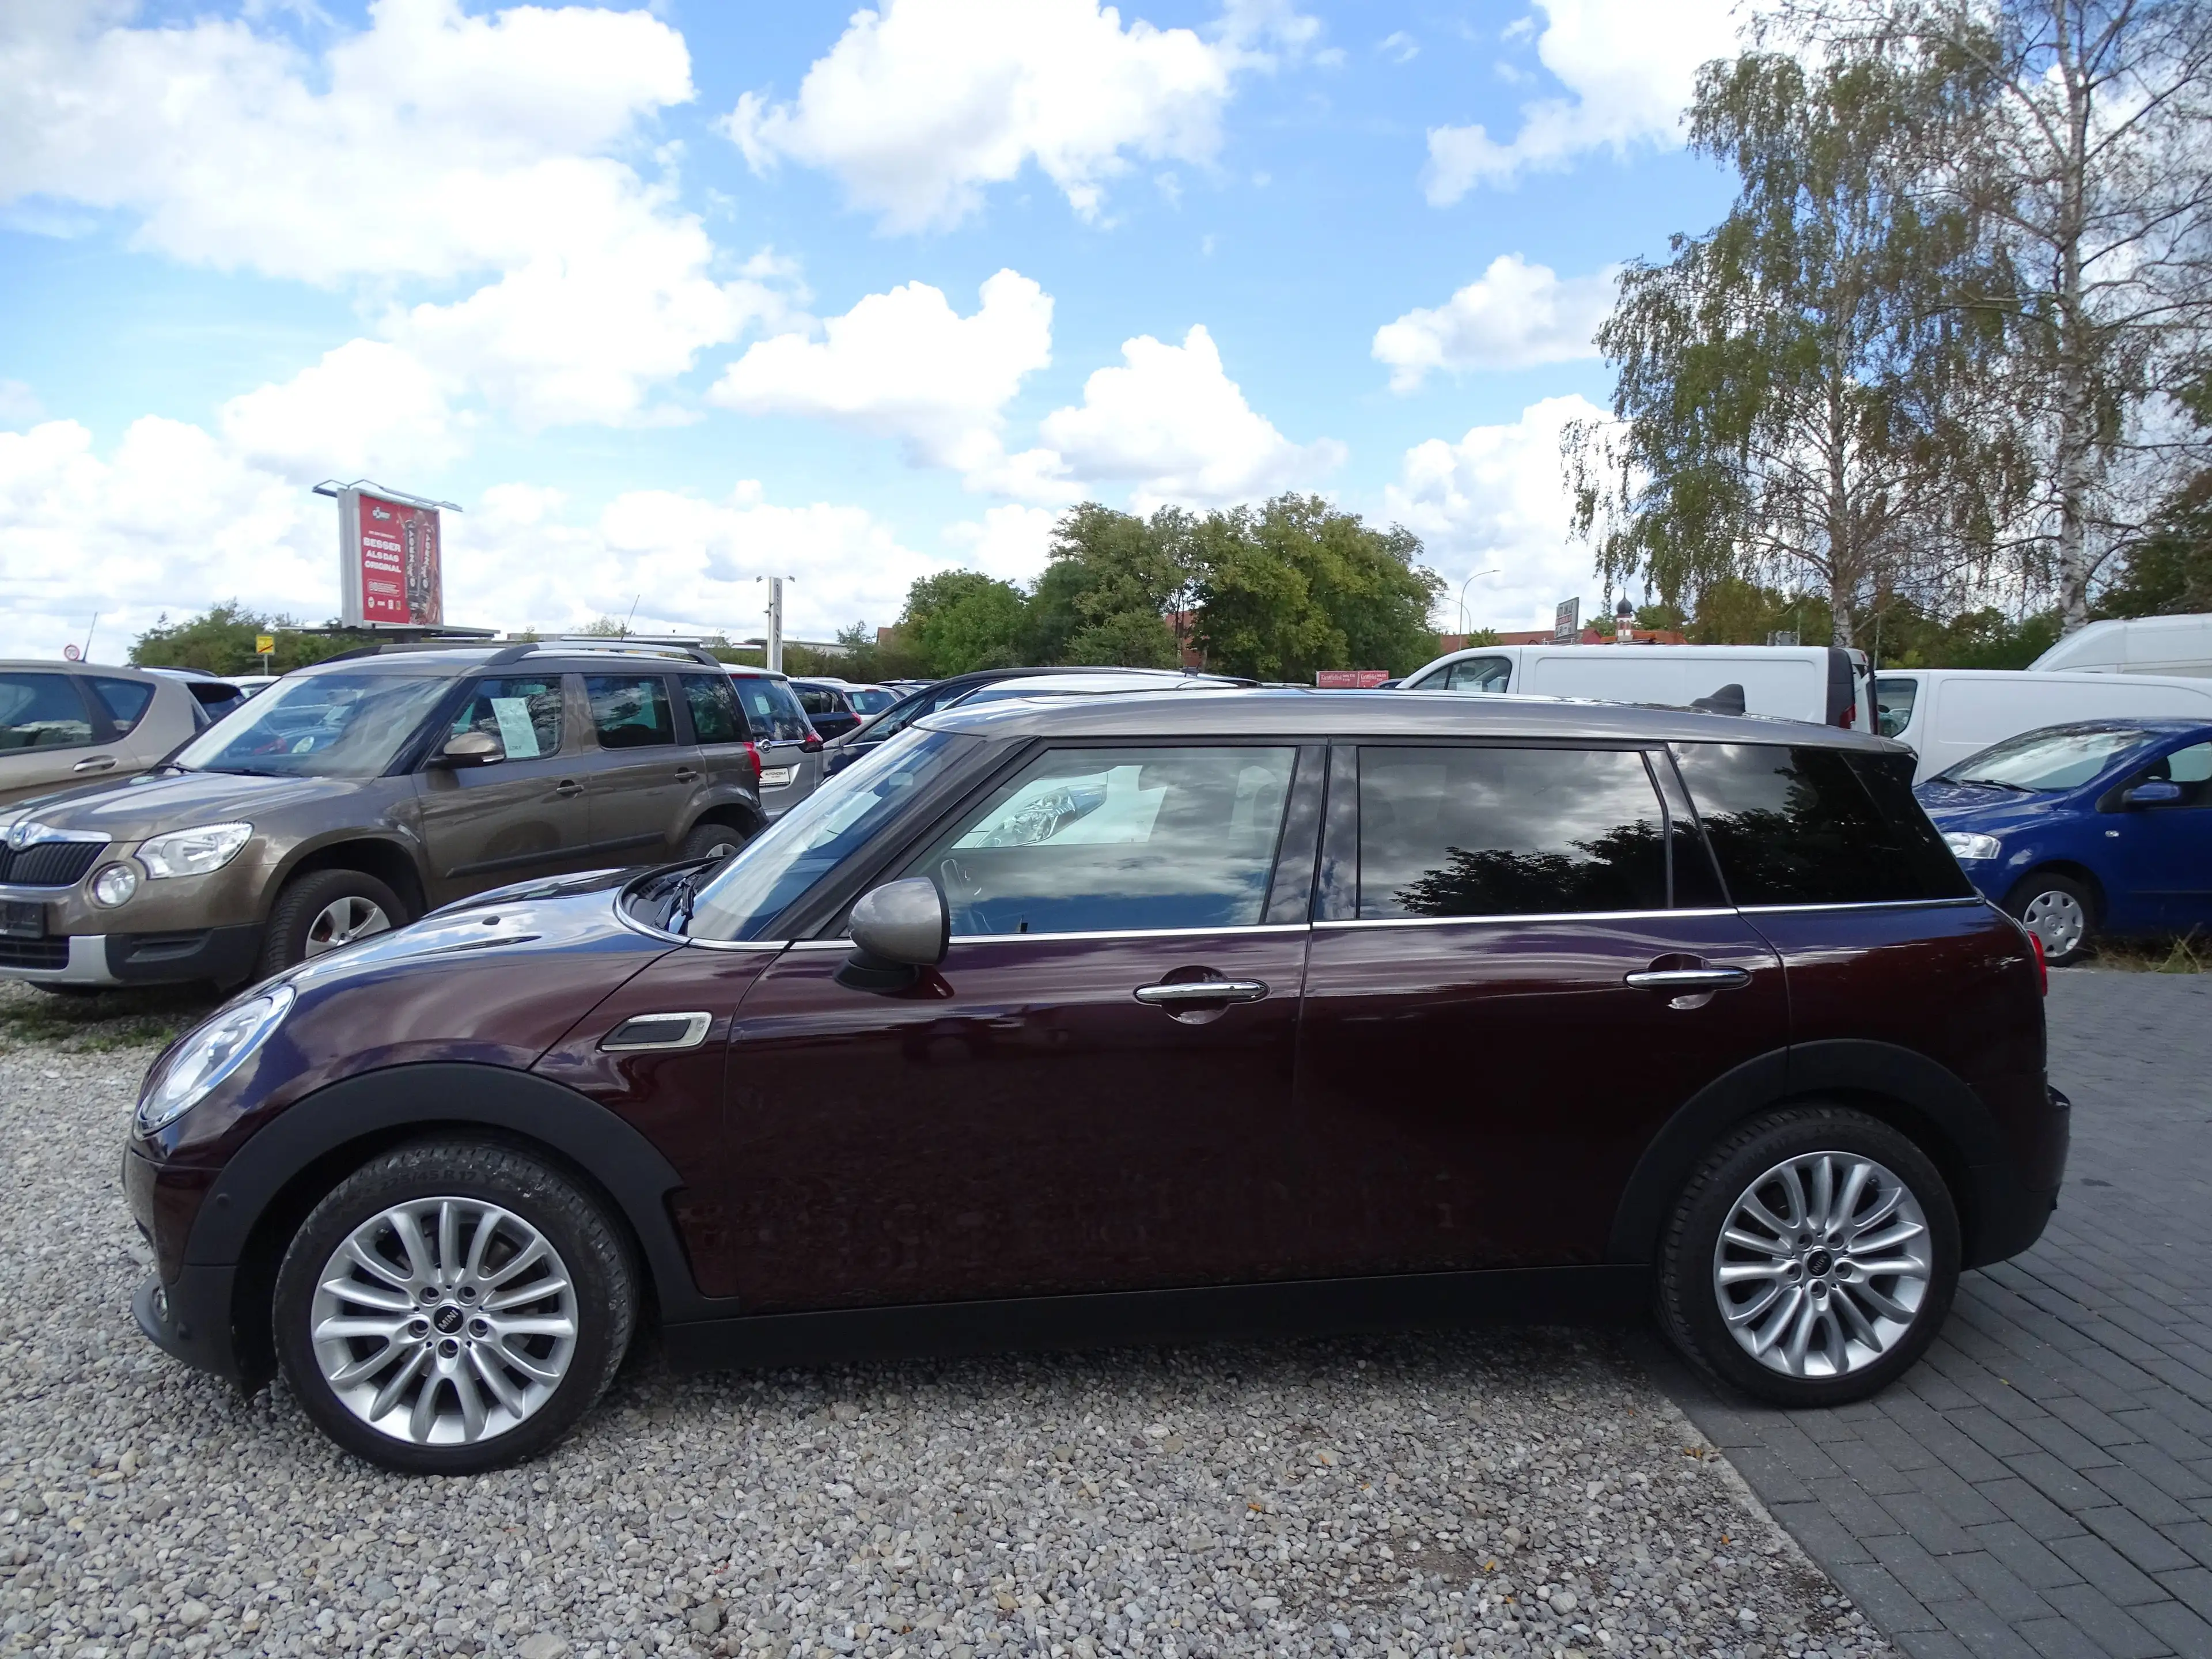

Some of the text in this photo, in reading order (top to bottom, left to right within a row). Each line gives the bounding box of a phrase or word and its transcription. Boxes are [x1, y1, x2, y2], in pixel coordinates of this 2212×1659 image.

[363, 537, 402, 553] BESSER
[366, 551, 399, 563] ALS DAS
[364, 560, 402, 573] ORIGINAL
[459, 1170, 477, 1181] 17
[1812, 1255, 1827, 1272] MINI
[438, 1309, 459, 1330] MINI
